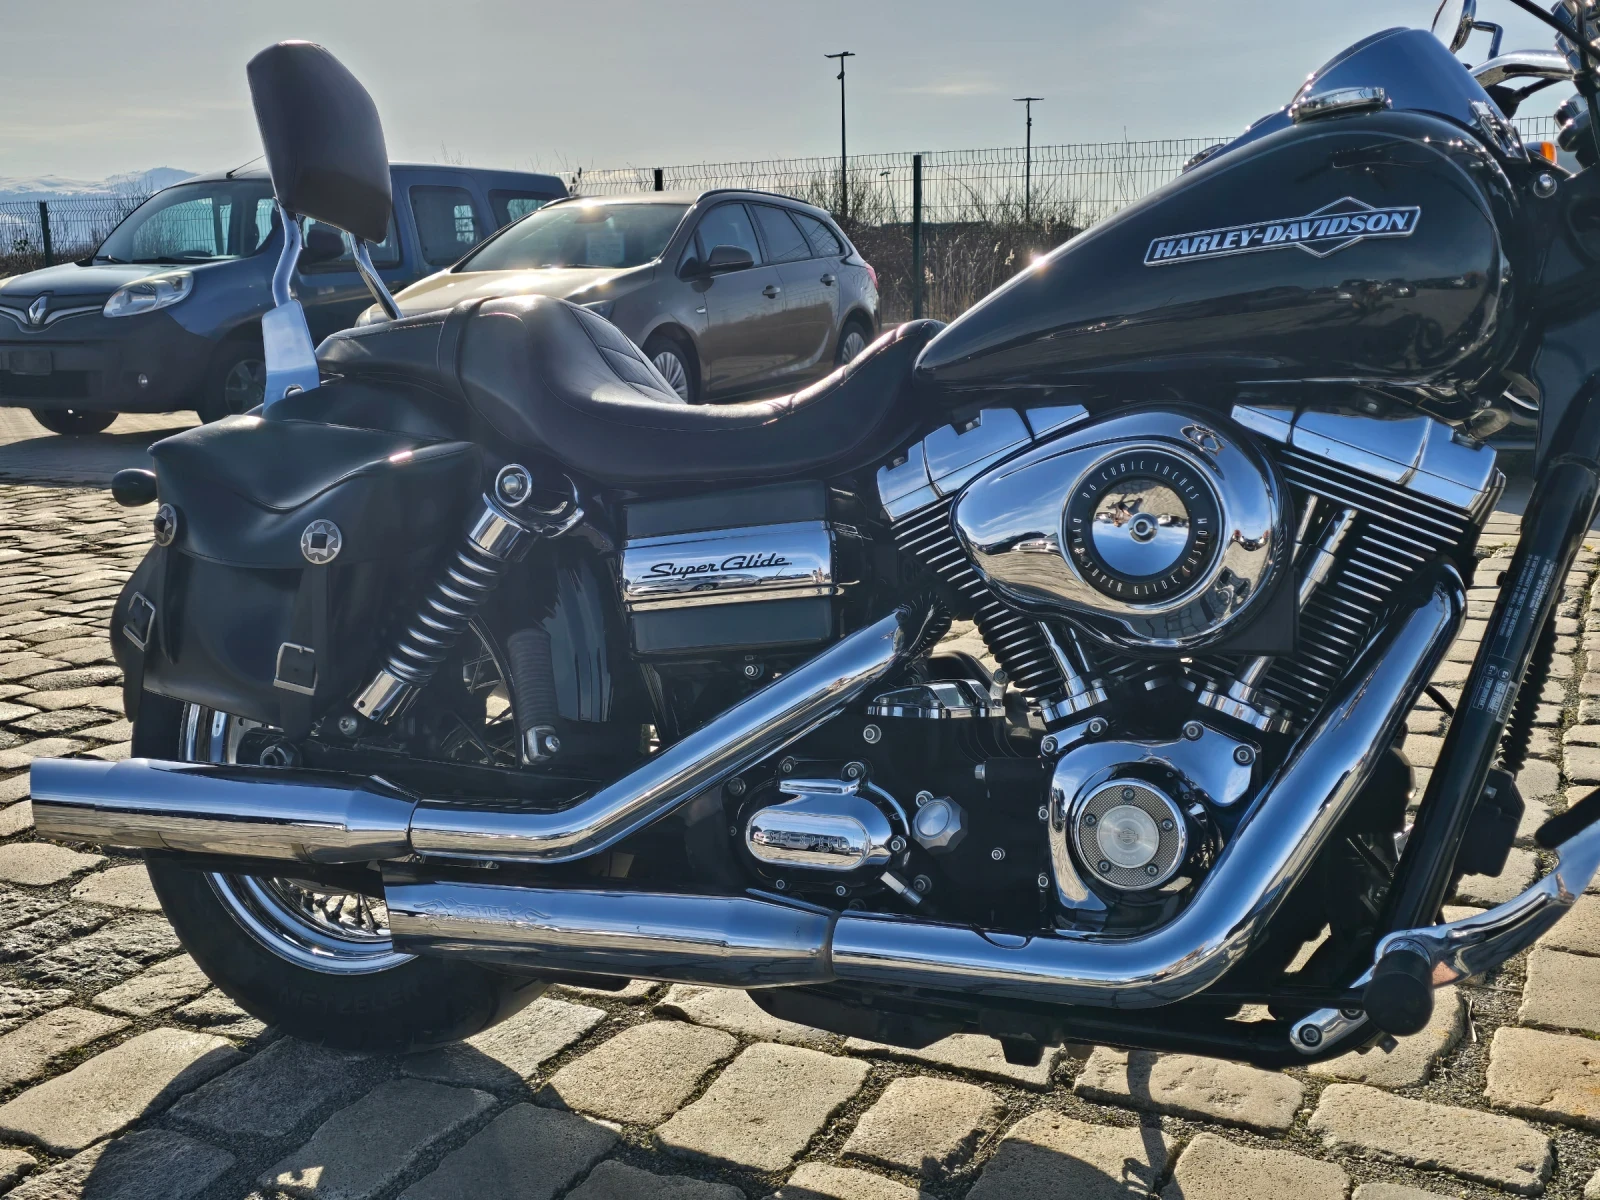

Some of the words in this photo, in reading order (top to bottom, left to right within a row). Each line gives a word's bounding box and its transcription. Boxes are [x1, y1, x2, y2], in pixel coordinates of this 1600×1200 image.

[1153, 211, 1411, 259] HARLEY-DAVIDSON
[1082, 483, 1097, 499] 96
[1101, 460, 1145, 481] CUBIC
[1154, 462, 1200, 500] INCHES
[641, 562, 720, 579] Super
[720, 552, 792, 571] Glide
[1084, 561, 1123, 592] SUPER
[1134, 575, 1181, 595] GLIDE
